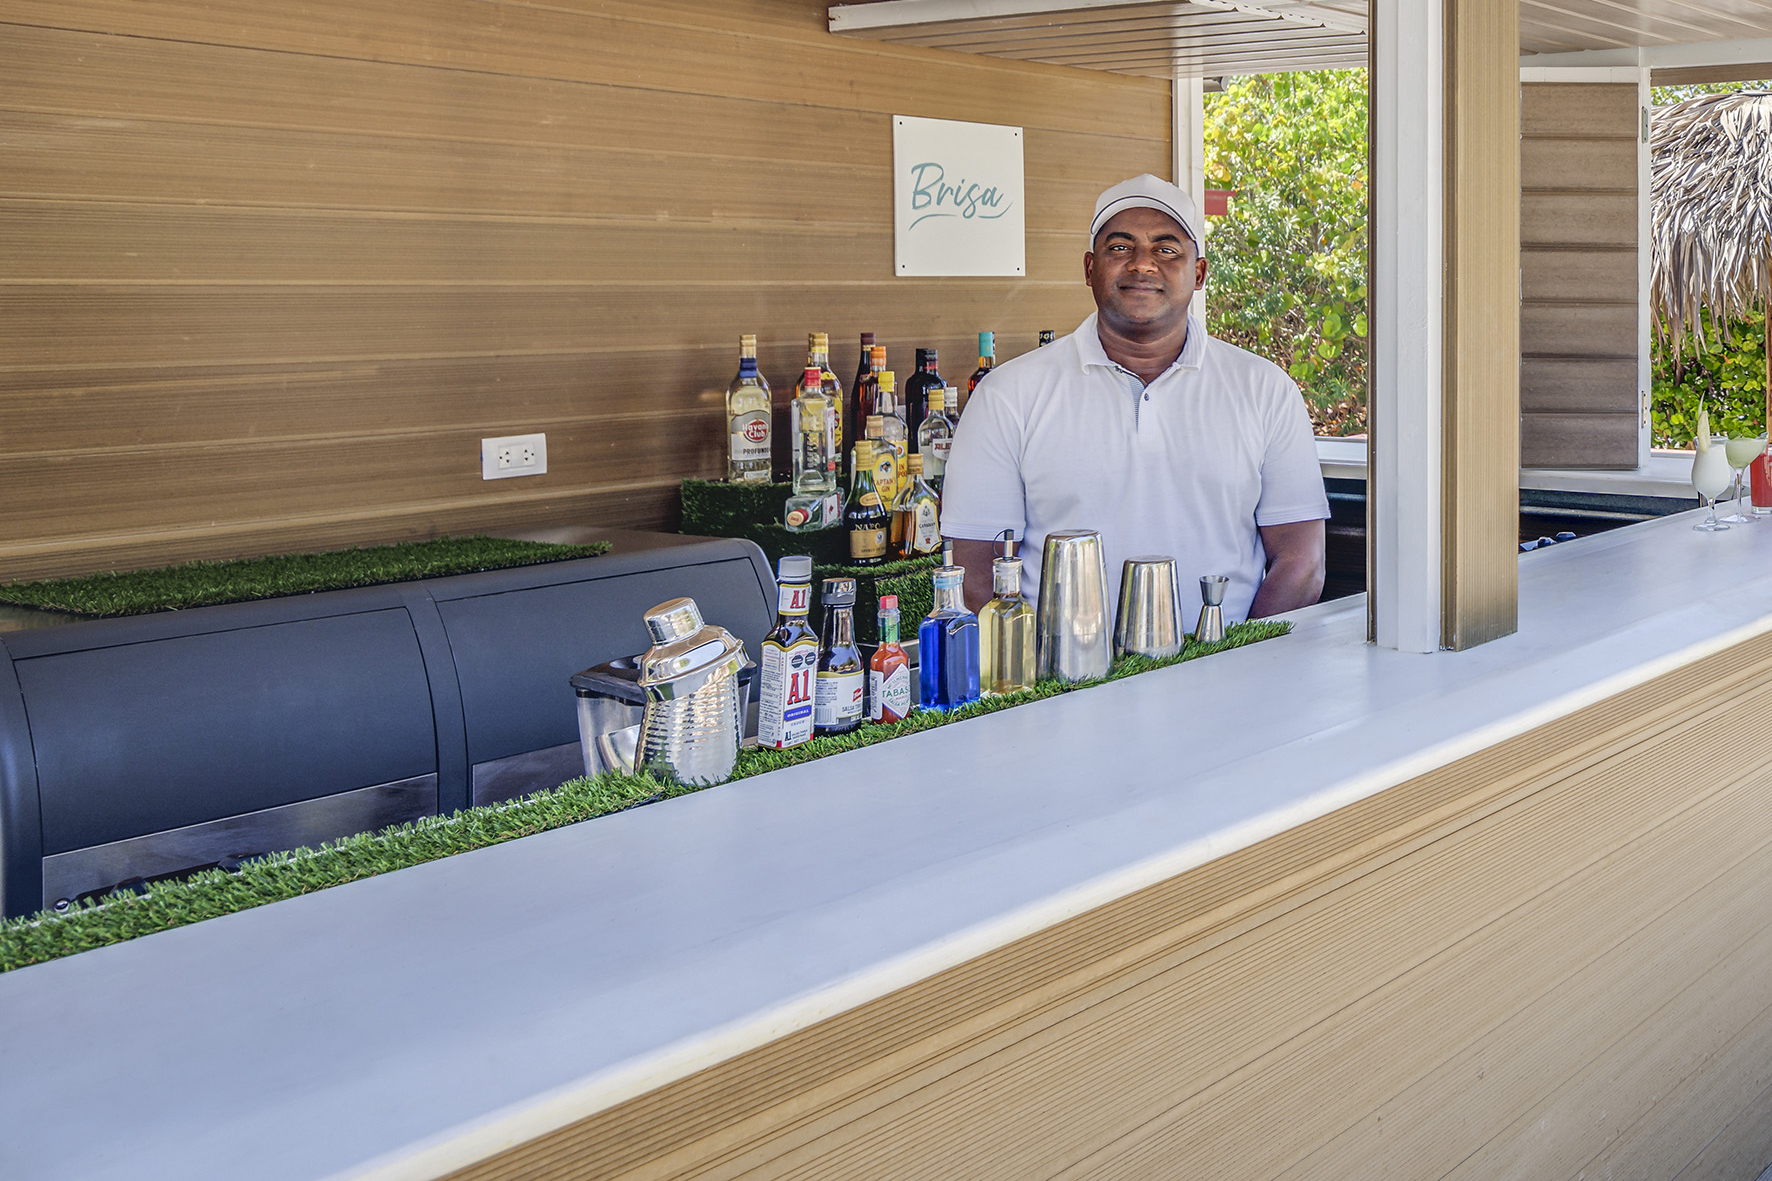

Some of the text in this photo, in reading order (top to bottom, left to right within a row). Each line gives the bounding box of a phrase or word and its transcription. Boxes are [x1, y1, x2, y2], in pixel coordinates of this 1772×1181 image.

[911, 162, 1004, 219] Brisa
[742, 423, 769, 431] Havan
[748, 429, 765, 438] Club
[790, 589, 806, 609] A1
[787, 668, 811, 705] A1
[882, 686, 909, 698] TABAS
